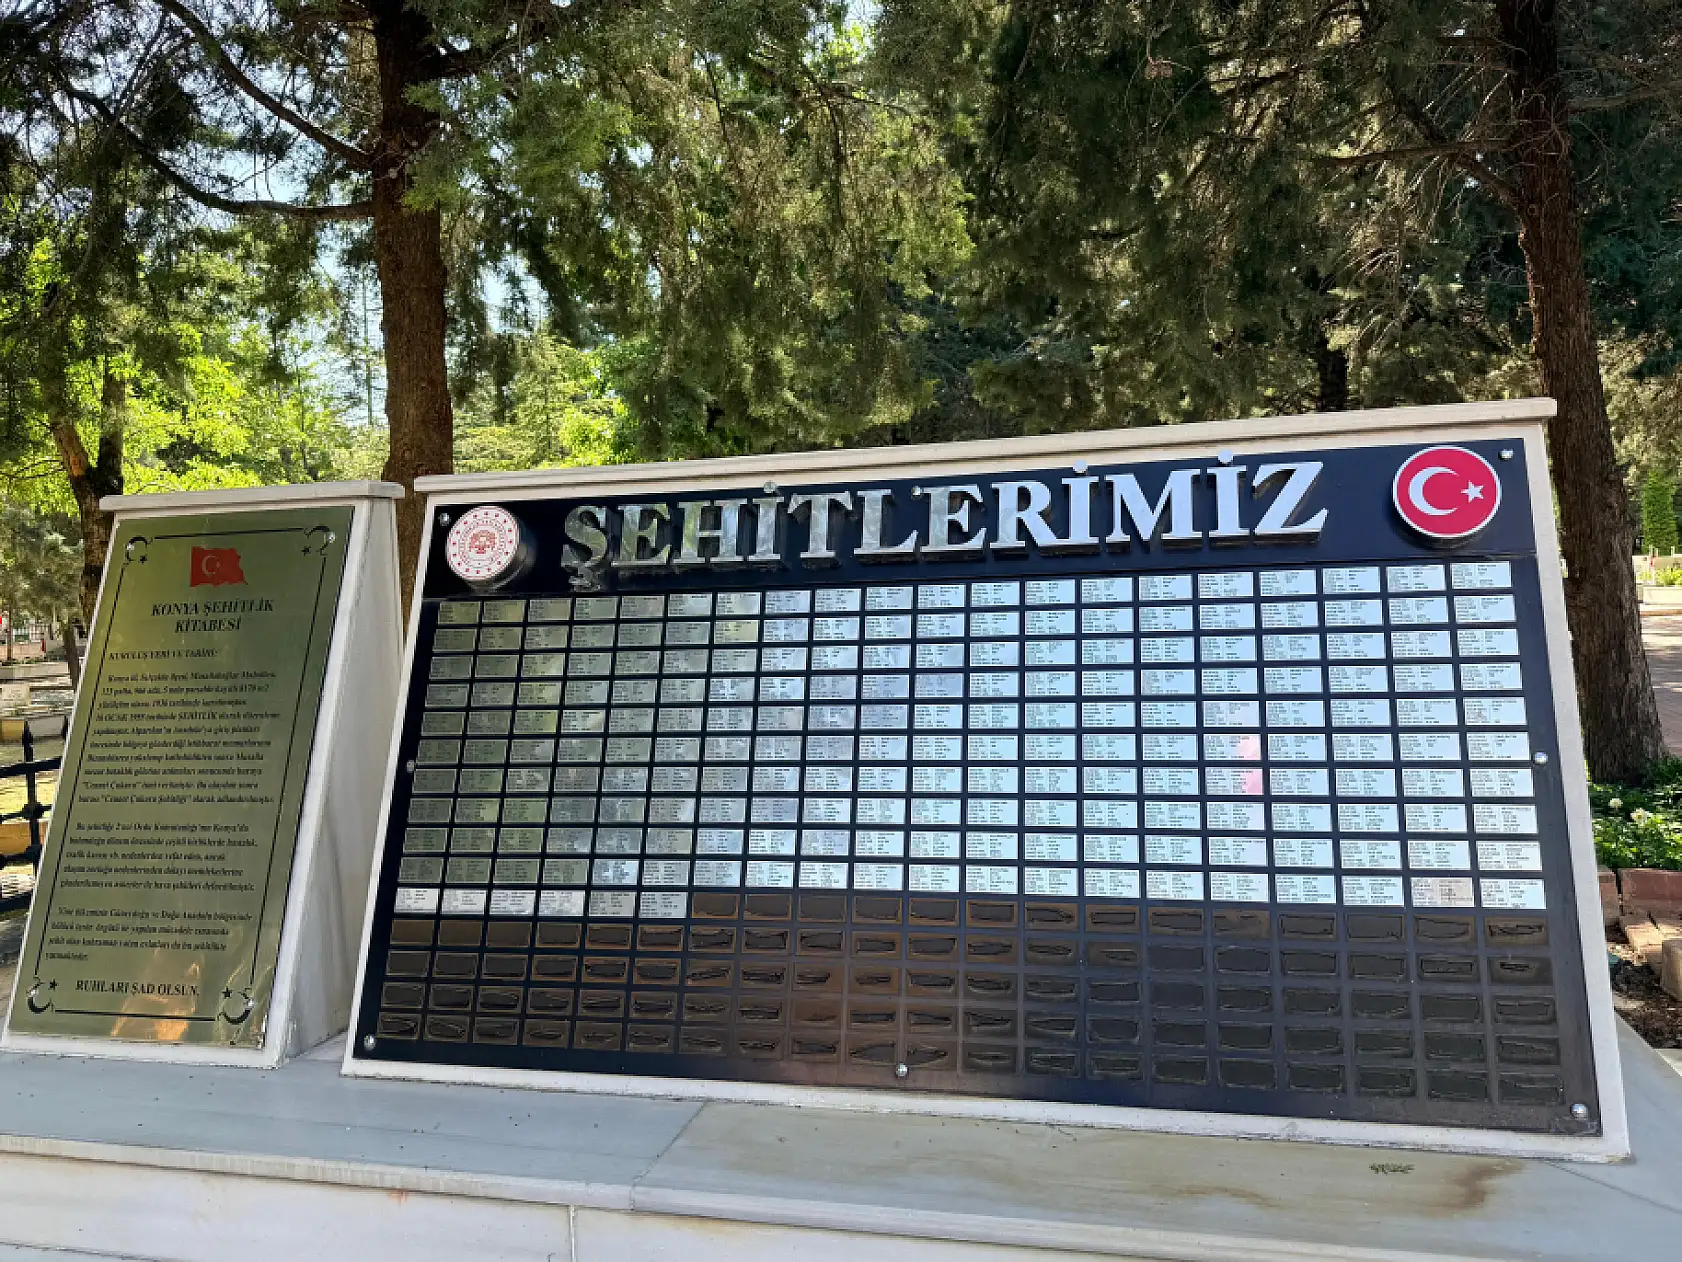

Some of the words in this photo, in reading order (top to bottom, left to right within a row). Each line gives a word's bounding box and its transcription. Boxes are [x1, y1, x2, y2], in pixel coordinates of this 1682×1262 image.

[561, 450, 1329, 591] ŞEHİTLERİMİZ
[151, 603, 199, 616] KONYA
[203, 597, 275, 616] ŞEHİTLİK
[174, 616, 242, 633] KİTABESİ
[75, 979, 130, 994] RUHLARI
[131, 982, 155, 997] ŞAD
